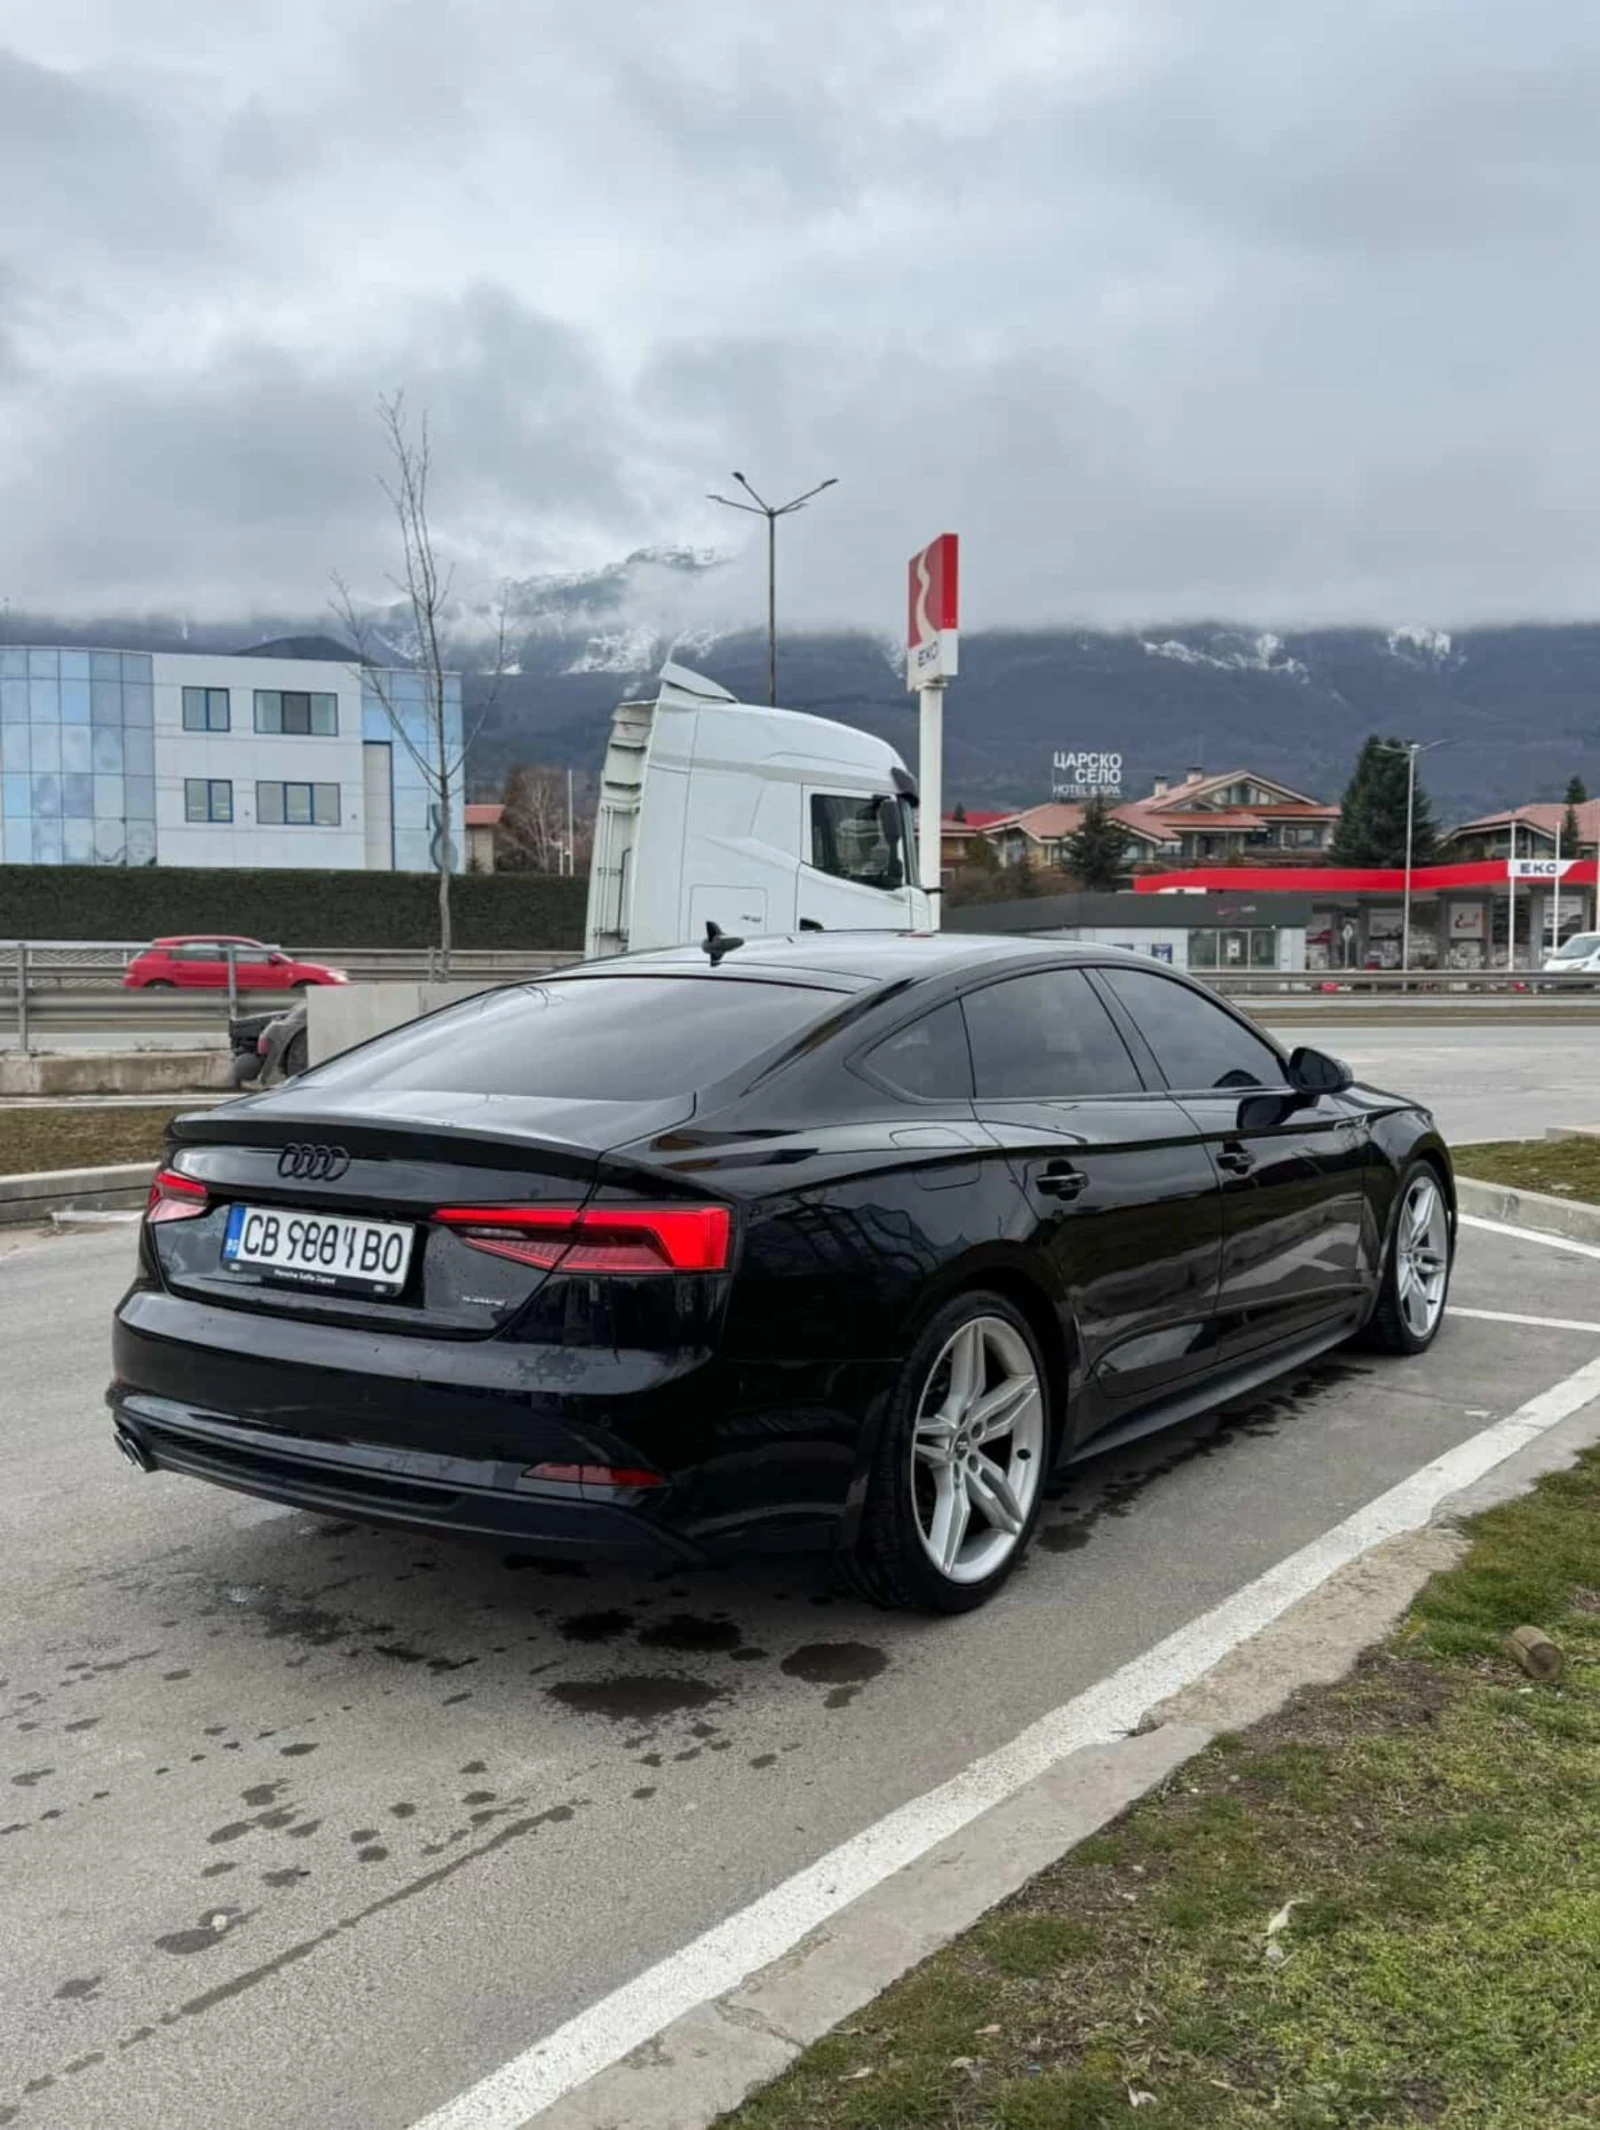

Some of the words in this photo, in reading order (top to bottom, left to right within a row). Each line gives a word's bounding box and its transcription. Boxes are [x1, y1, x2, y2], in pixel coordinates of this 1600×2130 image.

[1053, 752, 1122, 770] ЦАРСКО
[1075, 768, 1122, 784] СЕЛО
[1053, 784, 1086, 795] HOTEL
[243, 1214, 281, 1257] CB
[360, 1229, 403, 1275] BO
